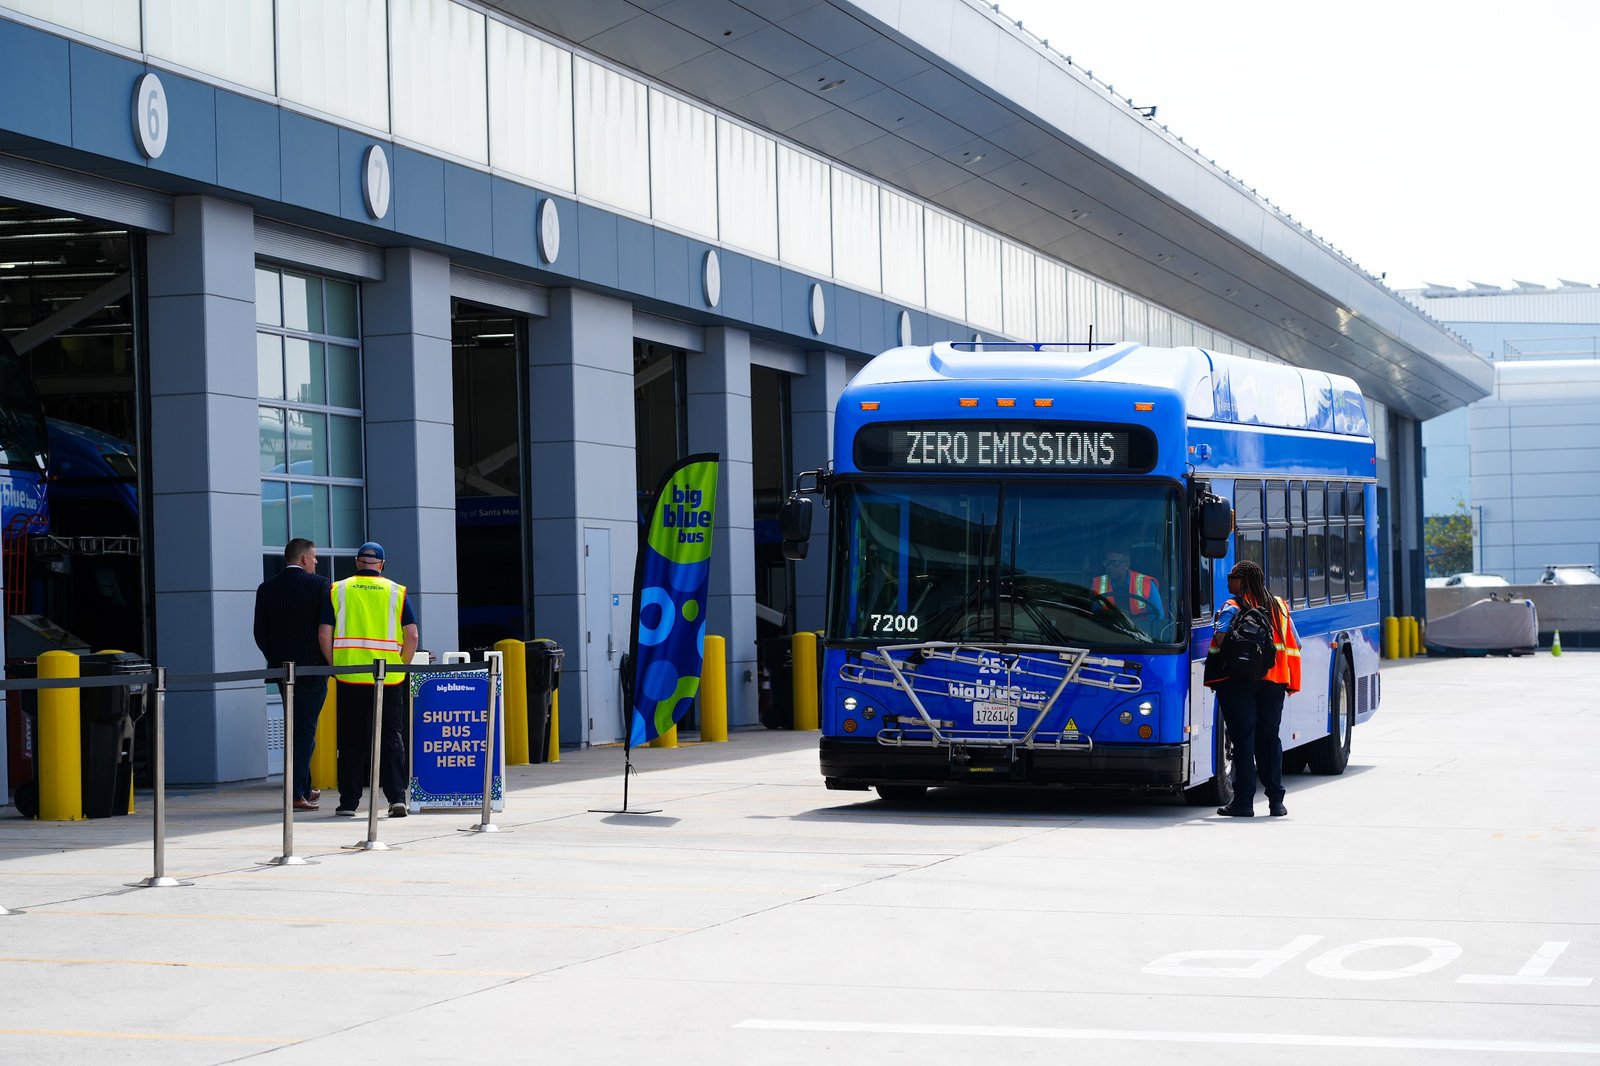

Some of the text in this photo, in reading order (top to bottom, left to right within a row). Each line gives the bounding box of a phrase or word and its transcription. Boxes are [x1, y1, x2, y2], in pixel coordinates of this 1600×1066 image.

[147, 90, 160, 141] 6
[374, 159, 383, 205] 7
[546, 210, 555, 250] 8
[906, 431, 1115, 465] ZERO EMISSIONS
[672, 483, 703, 509] big
[479, 509, 501, 517] Santa
[663, 504, 712, 528] blue
[677, 529, 705, 544] bus
[870, 614, 919, 632] 7200
[422, 710, 488, 723] SHUTTLE
[976, 710, 1015, 722] 1726146
[441, 725, 471, 738] BUS
[423, 740, 487, 753] DEPARTS
[436, 755, 476, 767] HERE
[1141, 934, 1593, 986] TOP
